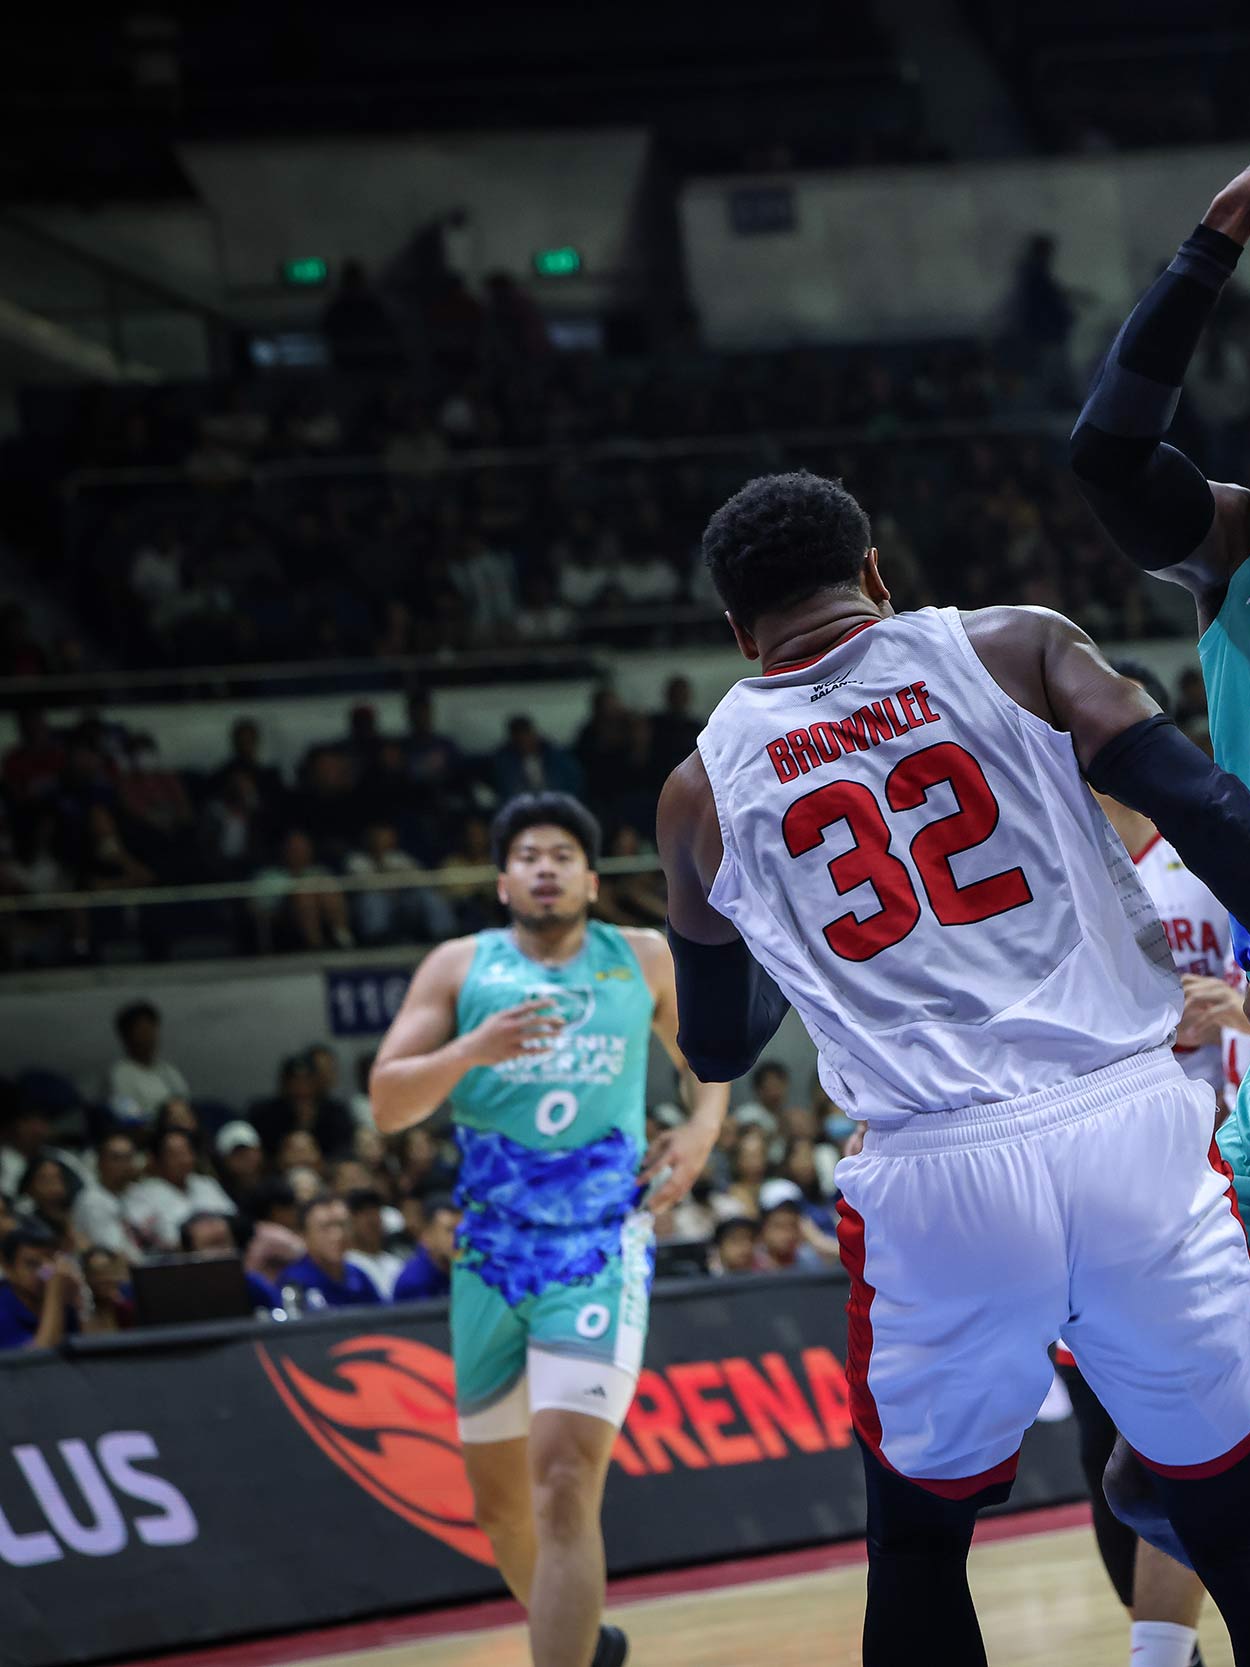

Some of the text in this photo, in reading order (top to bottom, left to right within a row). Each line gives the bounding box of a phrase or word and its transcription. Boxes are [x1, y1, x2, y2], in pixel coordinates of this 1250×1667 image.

[765, 680, 941, 784] BROWNLEE
[781, 741, 1034, 962] 32
[535, 1089, 580, 1137] 0
[575, 1303, 611, 1339] 0
